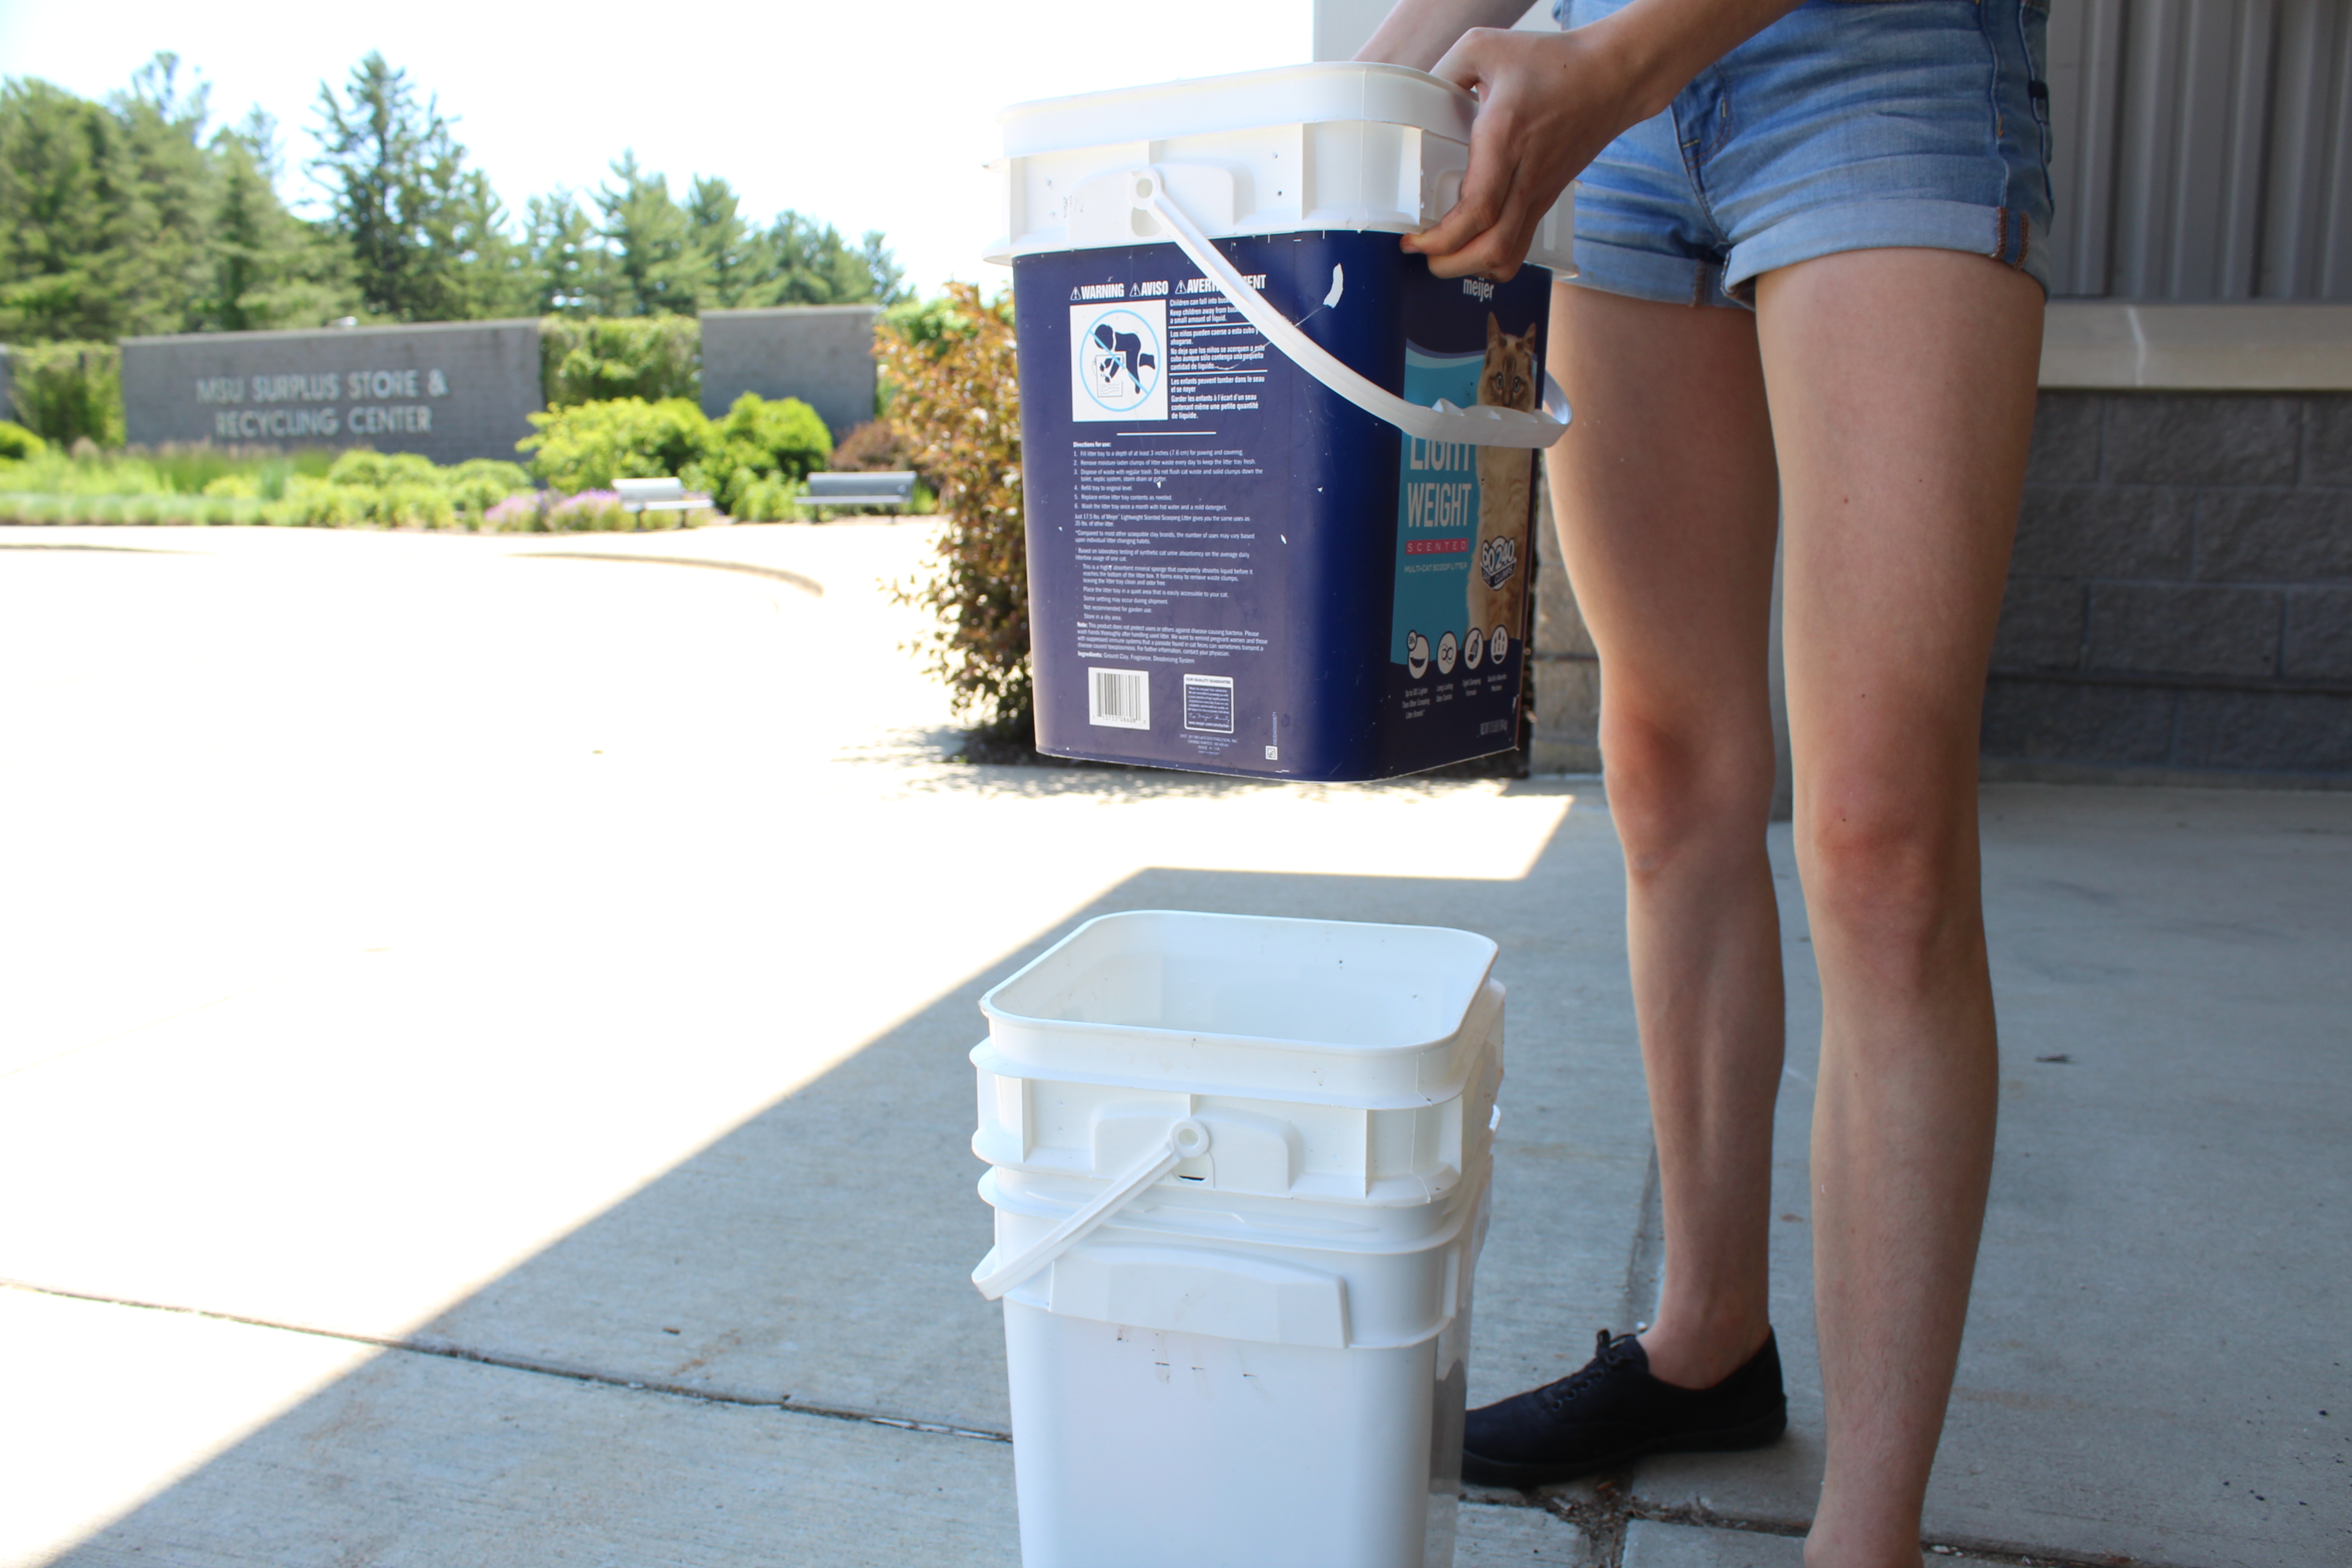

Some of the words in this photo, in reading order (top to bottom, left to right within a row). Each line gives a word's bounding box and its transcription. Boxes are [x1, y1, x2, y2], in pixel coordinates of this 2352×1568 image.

[1081, 283, 1124, 299] WARNING
[1141, 280, 1168, 296] AVISO
[1463, 278, 1494, 302] meijer
[1169, 298, 1189, 307] Children
[1170, 309, 1181, 317] Keep
[1211, 314, 1227, 323] liquid.
[196, 377, 245, 404] MSU
[252, 372, 340, 402] SURPLUS
[348, 369, 419, 400] STORE
[428, 369, 447, 397] &
[1197, 377, 1216, 385] peuvent
[1220, 402, 1235, 411] petite
[1236, 402, 1258, 410] quantité
[216, 408, 339, 438] RECYCLING
[348, 405, 432, 436] CENTER
[1179, 412, 1198, 420] liquide.
[1410, 436, 1471, 471] LIGHT
[1407, 483, 1472, 528] WEIGHT
[1407, 540, 1467, 552] SCENTED
